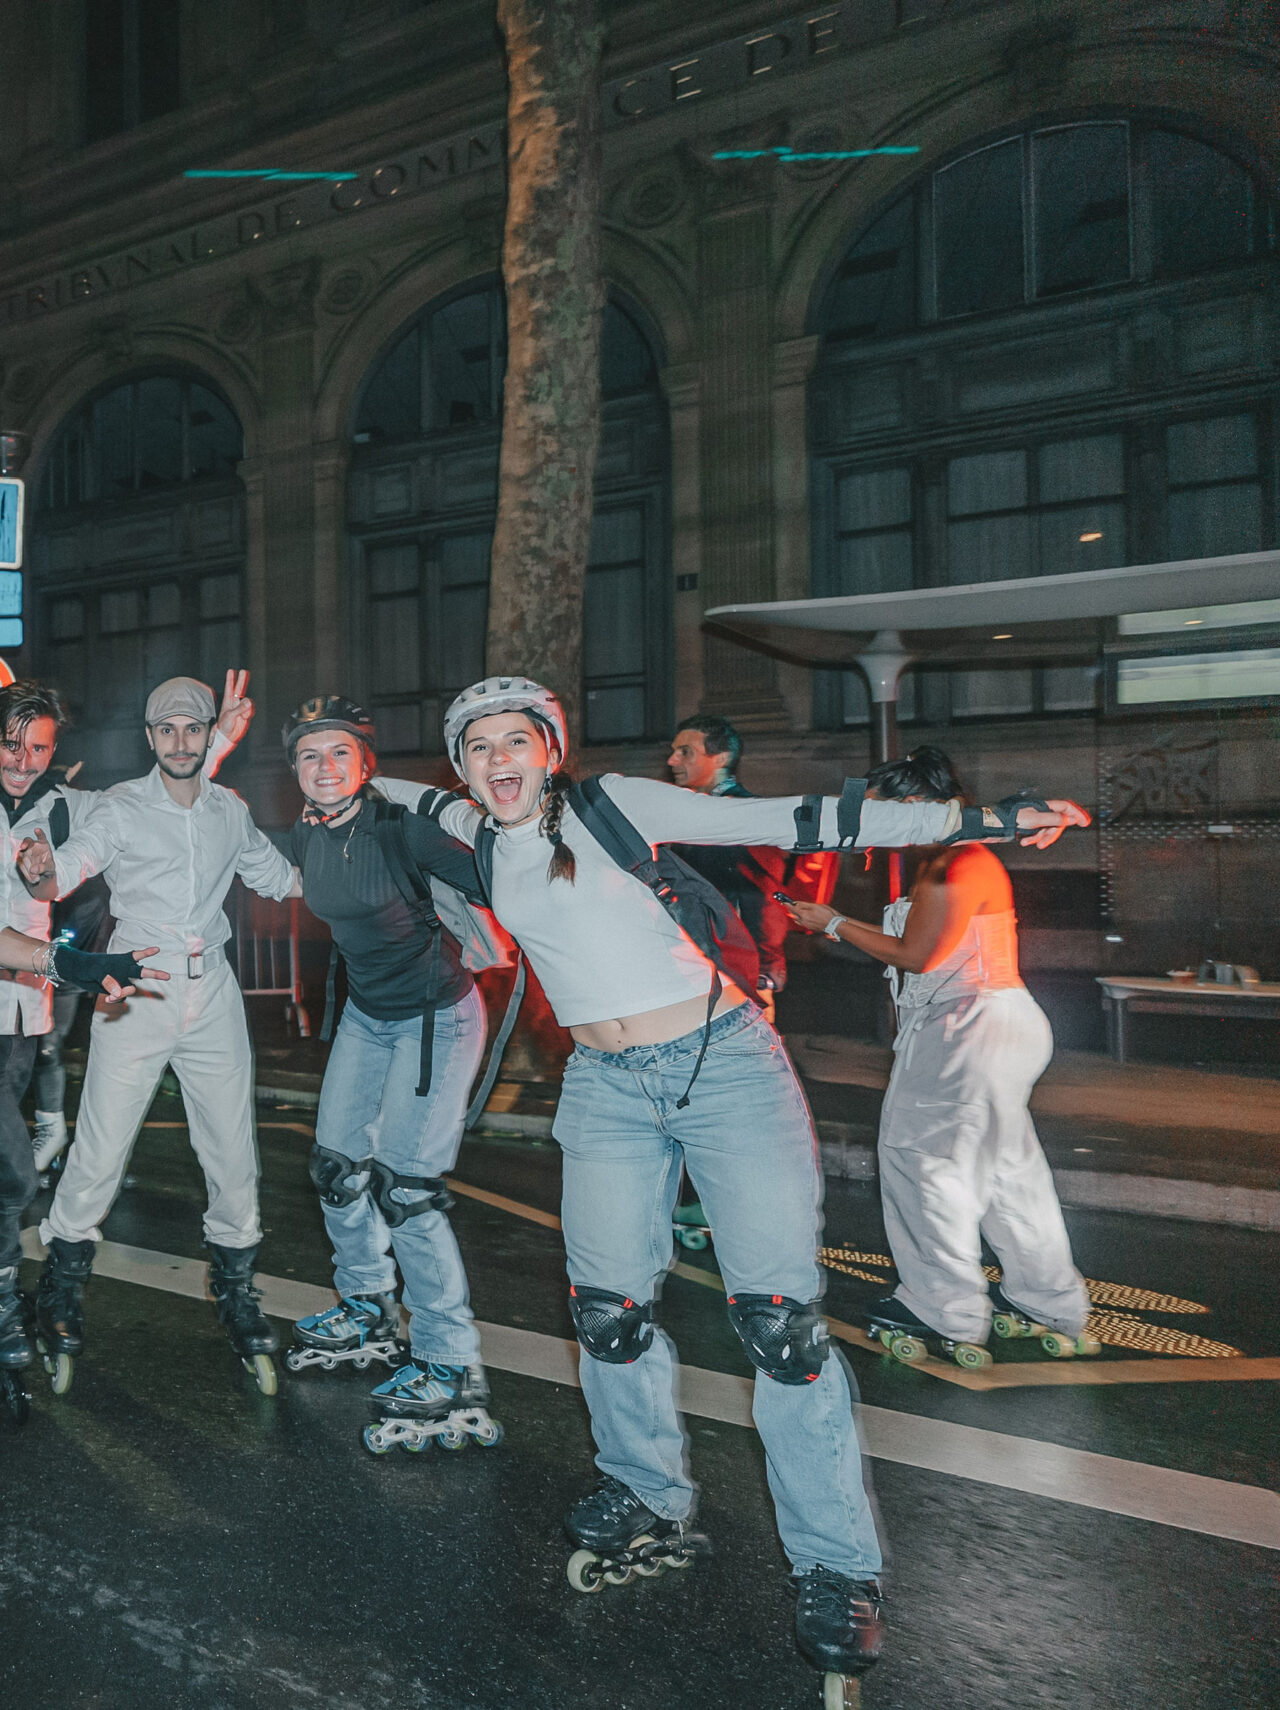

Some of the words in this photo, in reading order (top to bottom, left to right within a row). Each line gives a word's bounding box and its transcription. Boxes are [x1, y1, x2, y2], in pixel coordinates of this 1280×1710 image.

[0, 231, 213, 319] TRIBVNAL
[237, 198, 302, 246] DE
[745, 11, 841, 76] DE
